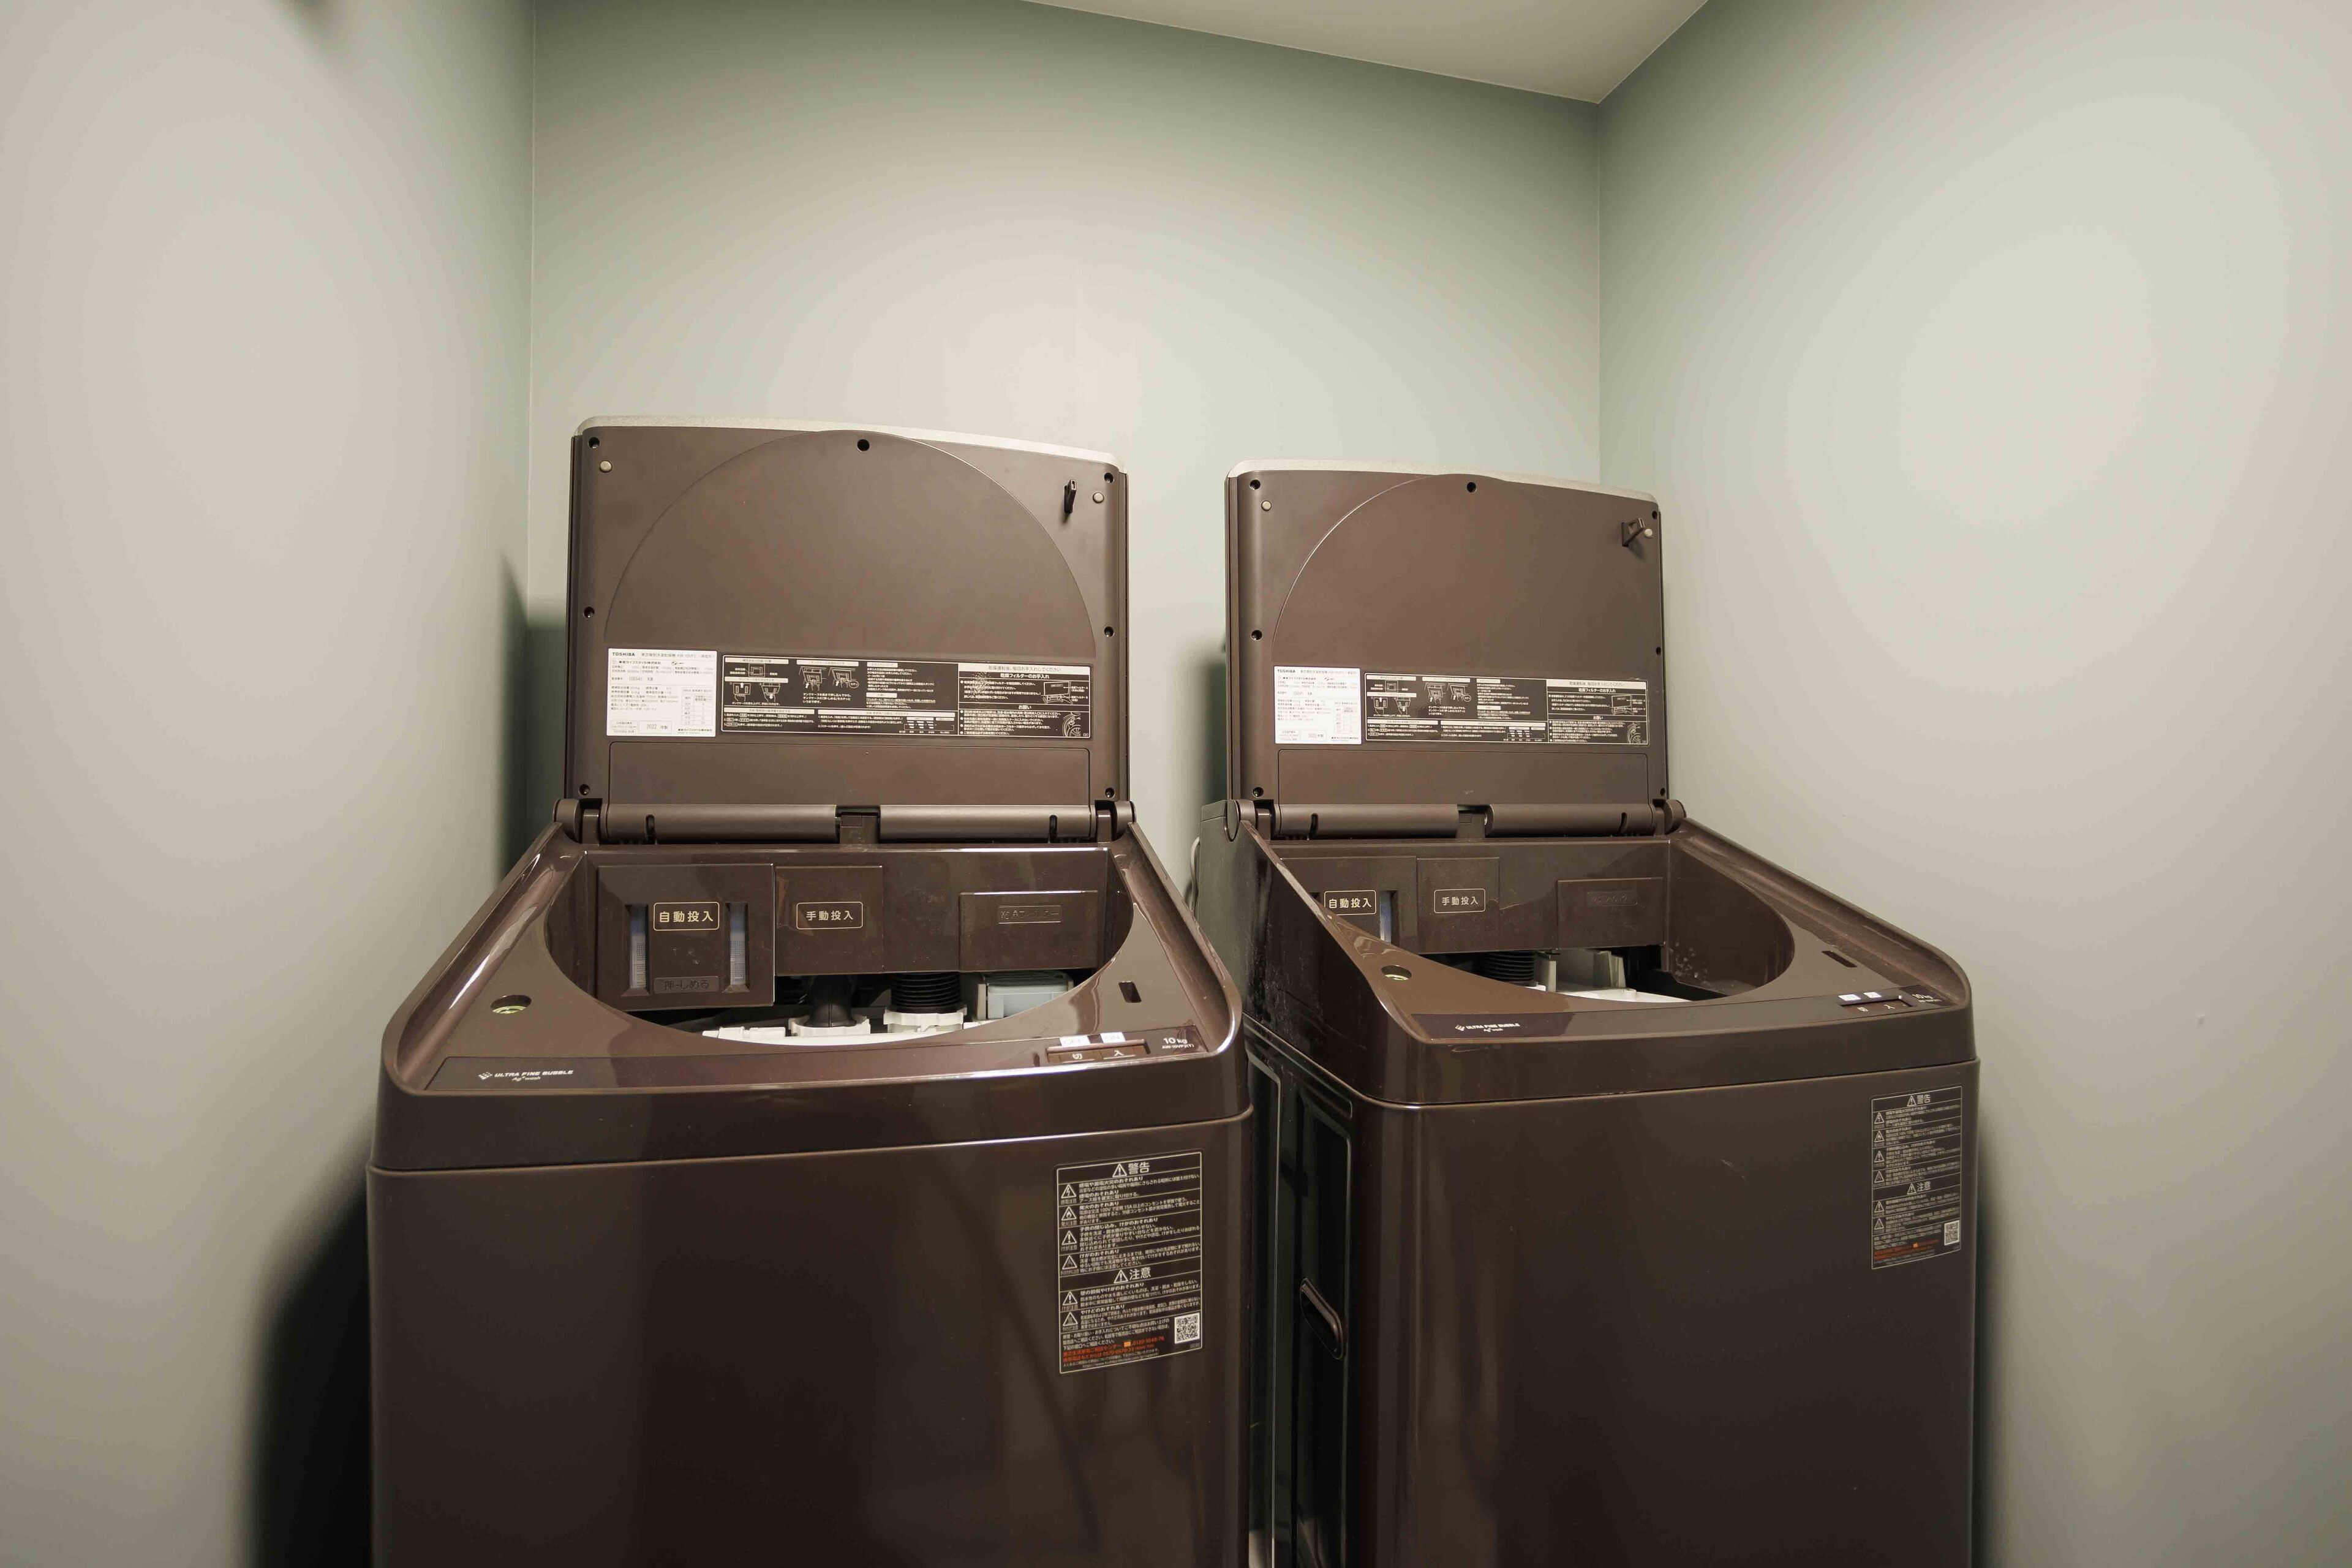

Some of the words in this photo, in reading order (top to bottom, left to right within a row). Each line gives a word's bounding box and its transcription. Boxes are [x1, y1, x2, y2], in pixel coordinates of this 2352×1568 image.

[1329, 897, 1372, 908] 自動投入
[1441, 896, 1479, 906] 手動投入
[660, 911, 713, 922] 自動投入
[806, 910, 853, 921] 手動投入
[1128, 1161, 1150, 1175] 警告
[1917, 1181, 1931, 1192] 注意
[1079, 1189, 1118, 1199] 感電のおそれあり
[1079, 1200, 1118, 1210] 発火のおそれあり
[1079, 1248, 1119, 1259] けがのおそれあり
[1129, 1267, 1151, 1281] 注意
[1080, 1303, 1125, 1315] やけどのおそれあり
